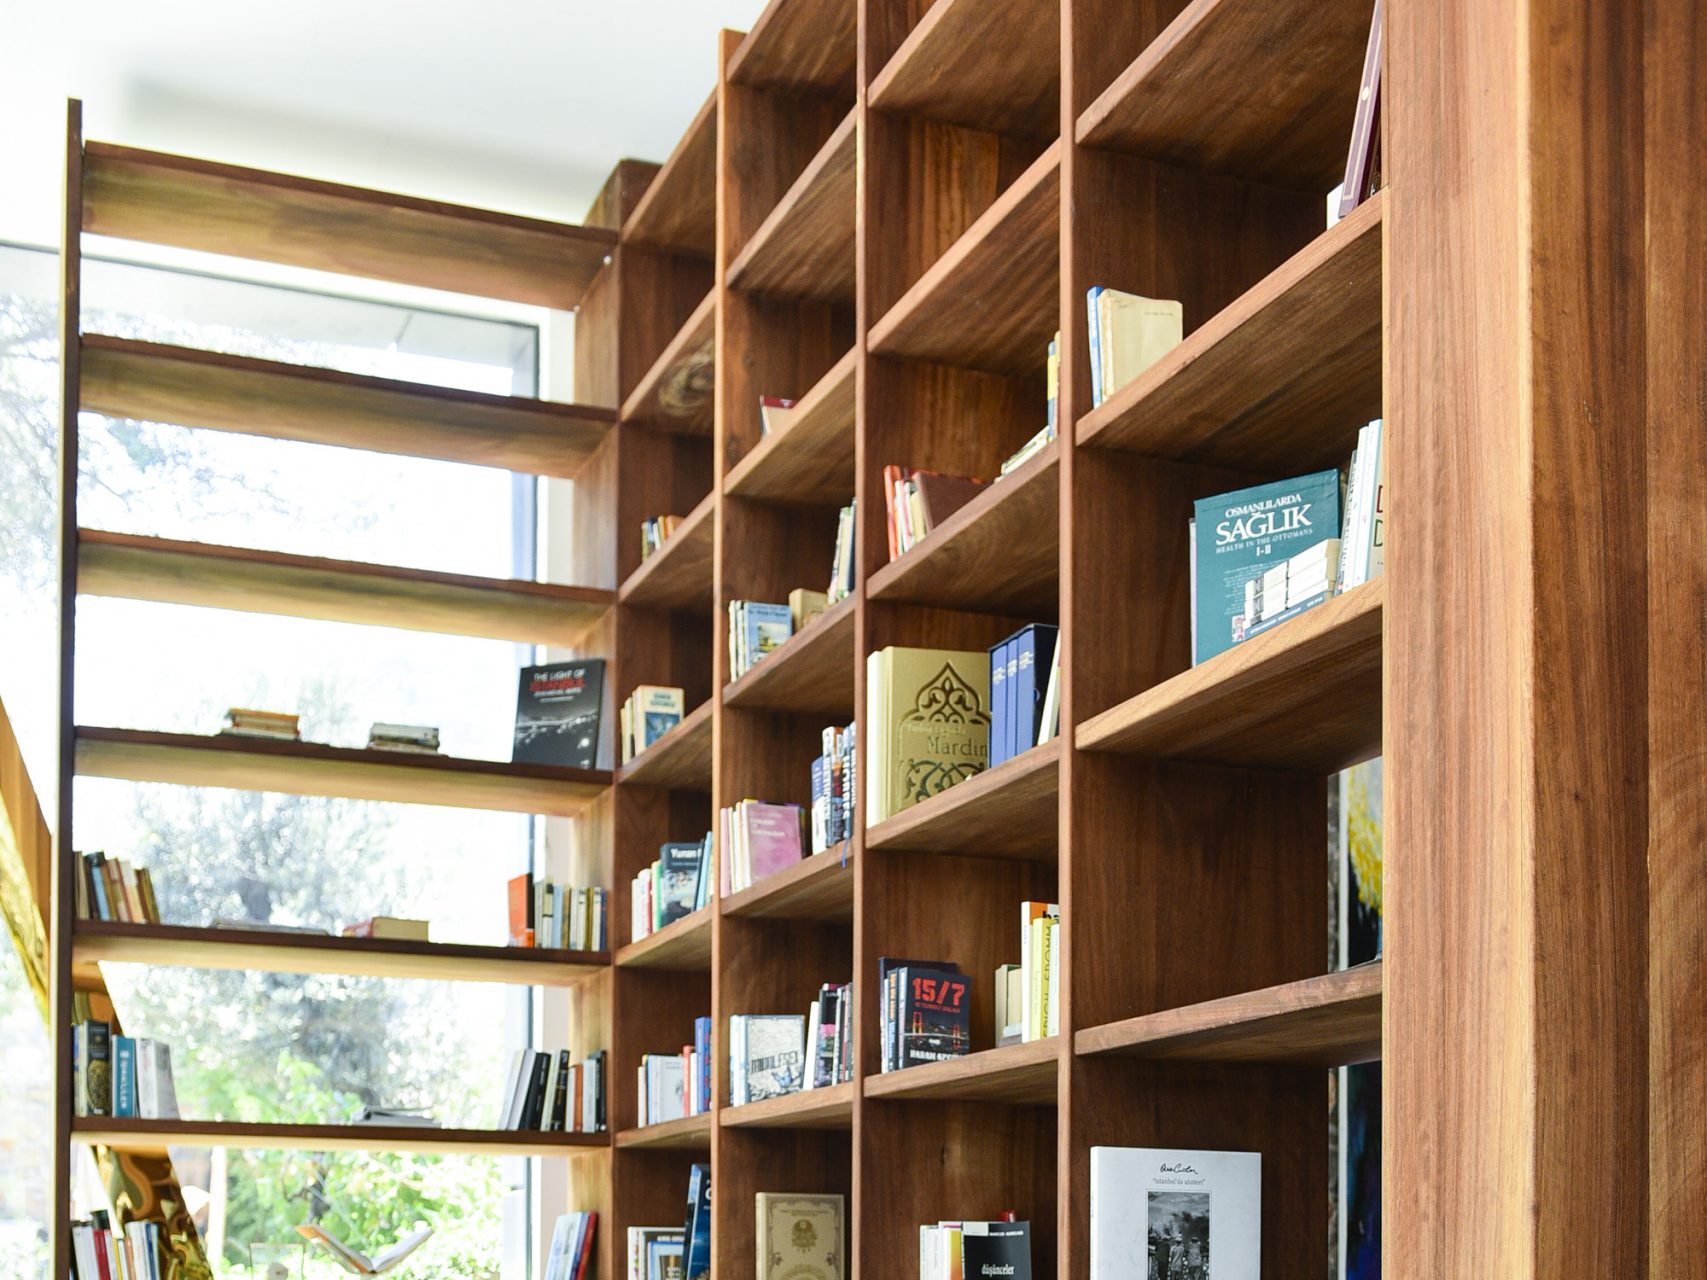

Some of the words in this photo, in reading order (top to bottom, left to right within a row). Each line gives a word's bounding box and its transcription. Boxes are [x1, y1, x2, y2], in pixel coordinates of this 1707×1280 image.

[1225, 493, 1302, 518] OSMANLILARDA
[1216, 503, 1312, 546] SAĞLIK
[1216, 542, 1245, 554] HEALTH
[1256, 537, 1270, 546] THE
[1272, 528, 1313, 543] OTTOMANS
[927, 735, 988, 756] Mardin
[842, 755, 851, 820] HOBBES
[912, 977, 965, 1006] 15/7
[981, 1263, 1015, 1277] düşünceler
